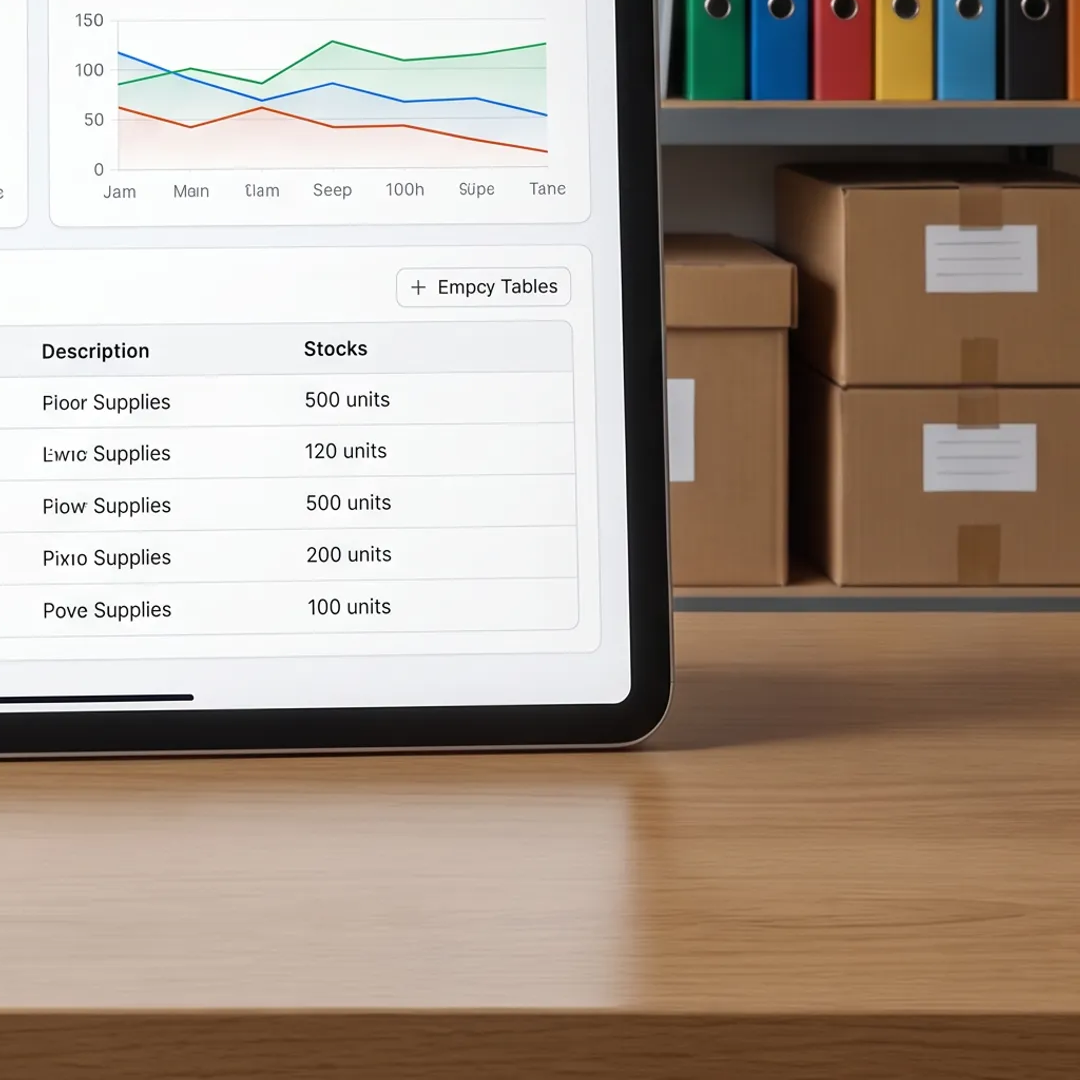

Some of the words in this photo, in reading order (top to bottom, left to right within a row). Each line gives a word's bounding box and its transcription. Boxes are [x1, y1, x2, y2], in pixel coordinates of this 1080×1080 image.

[75, 12, 104, 28] 150
[75, 62, 104, 77] 100
[84, 112, 104, 127] 50
[93, 162, 104, 177] 0
[103, 185, 137, 199] Jam
[313, 182, 353, 200] Seep
[385, 182, 425, 197] 100h
[529, 181, 566, 196] Tane
[500, 278, 558, 294] Tables
[42, 342, 150, 363] Description
[304, 340, 368, 357] Stocks
[93, 393, 171, 415] Supplies
[305, 391, 340, 409] 500
[346, 390, 391, 408] units
[93, 444, 171, 466] Supplies
[305, 442, 337, 459] 120
[343, 441, 387, 459] units
[93, 496, 172, 518] Supplies
[306, 494, 341, 512] 500
[347, 493, 392, 511] units
[93, 548, 172, 570] Supplies
[306, 546, 342, 563] 200
[348, 545, 392, 563] units
[43, 602, 88, 619] Pove
[94, 600, 172, 622] Supplies
[307, 598, 341, 616] 100
[347, 597, 392, 615] units
